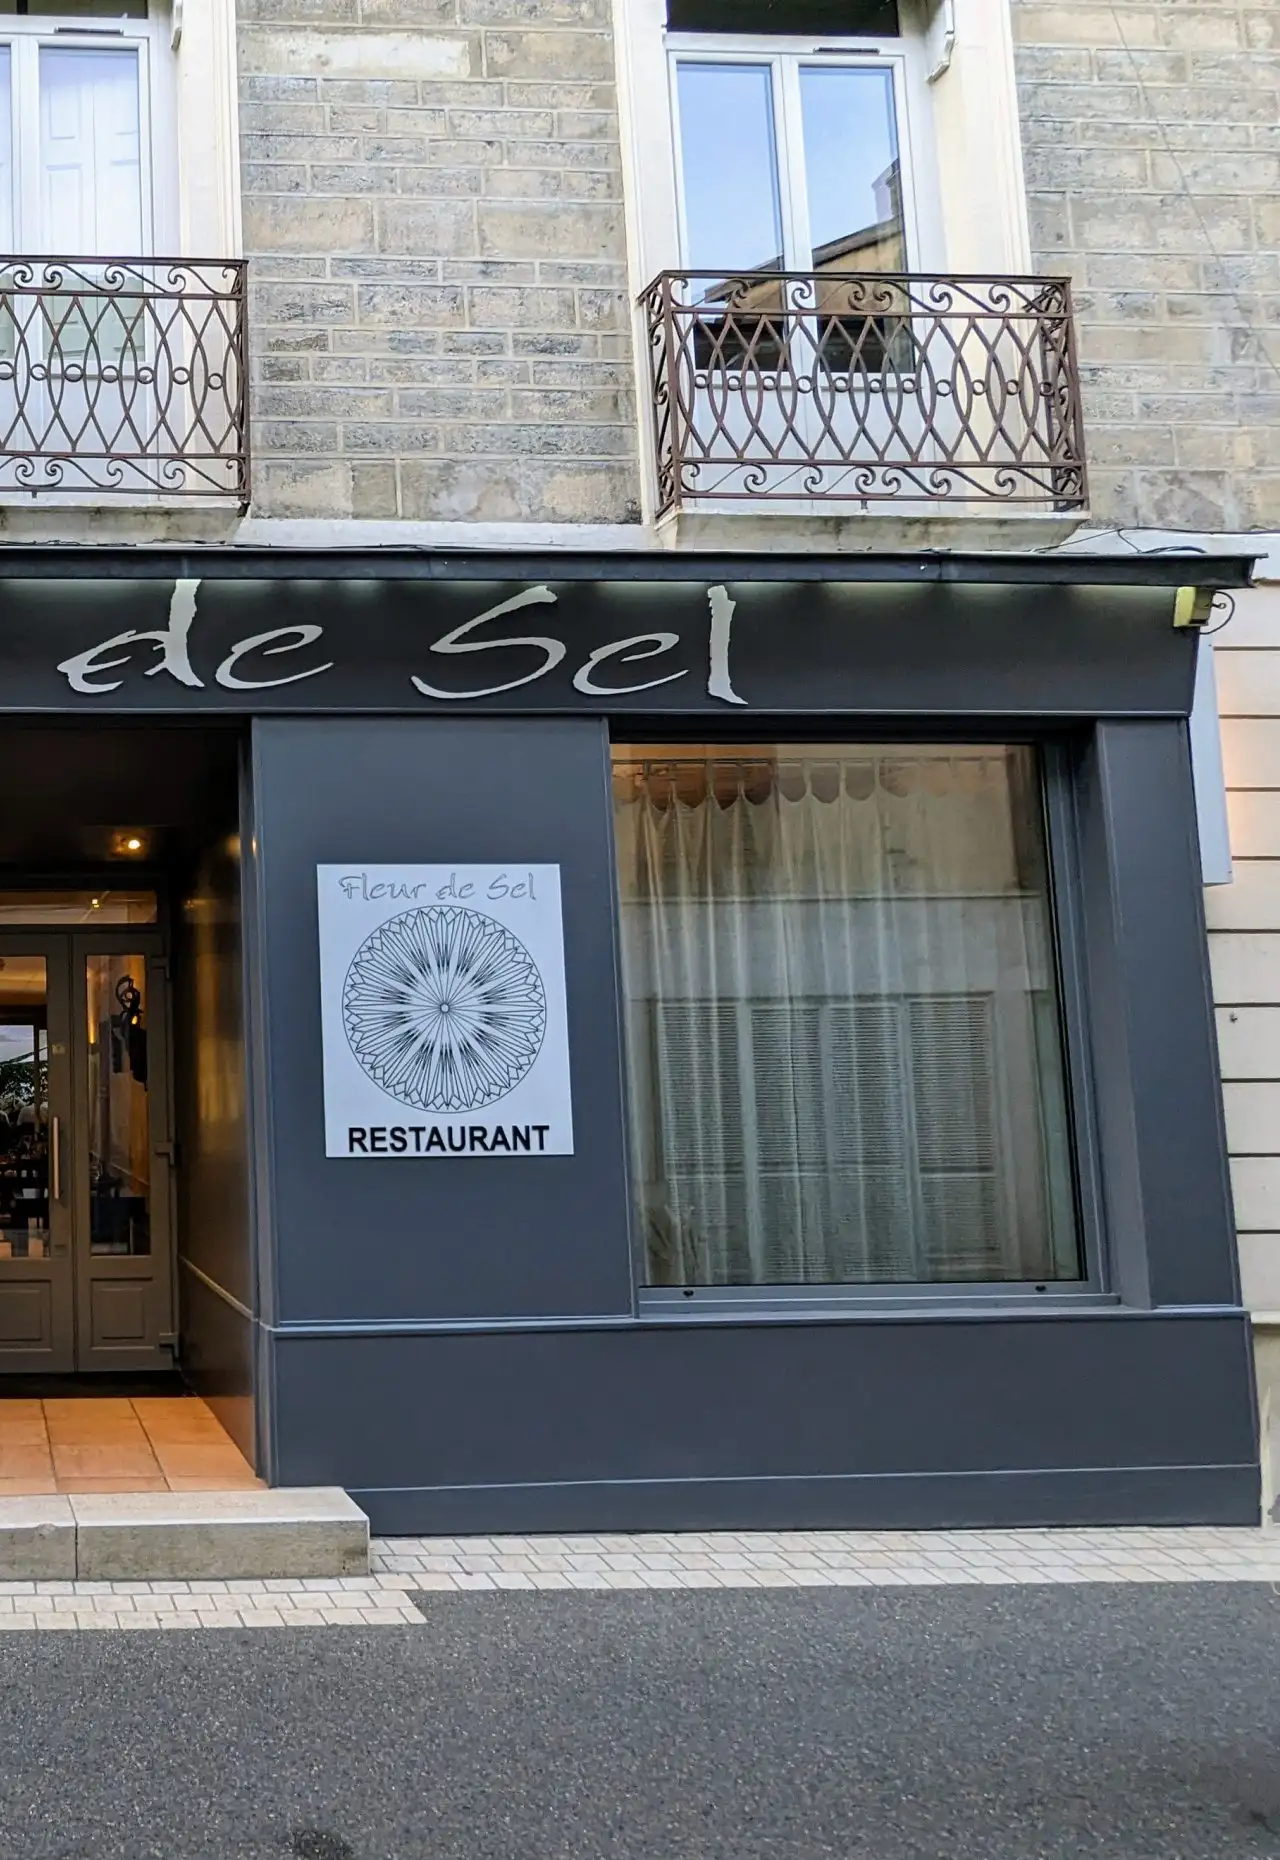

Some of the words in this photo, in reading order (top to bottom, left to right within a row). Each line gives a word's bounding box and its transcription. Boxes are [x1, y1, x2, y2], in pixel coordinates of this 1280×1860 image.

[57, 578, 333, 693] de
[411, 584, 748, 705] Sel
[337, 872, 427, 901] Fleur
[434, 872, 477, 900] de
[486, 872, 538, 900] Sel
[348, 1125, 550, 1153] RESTAURANT
